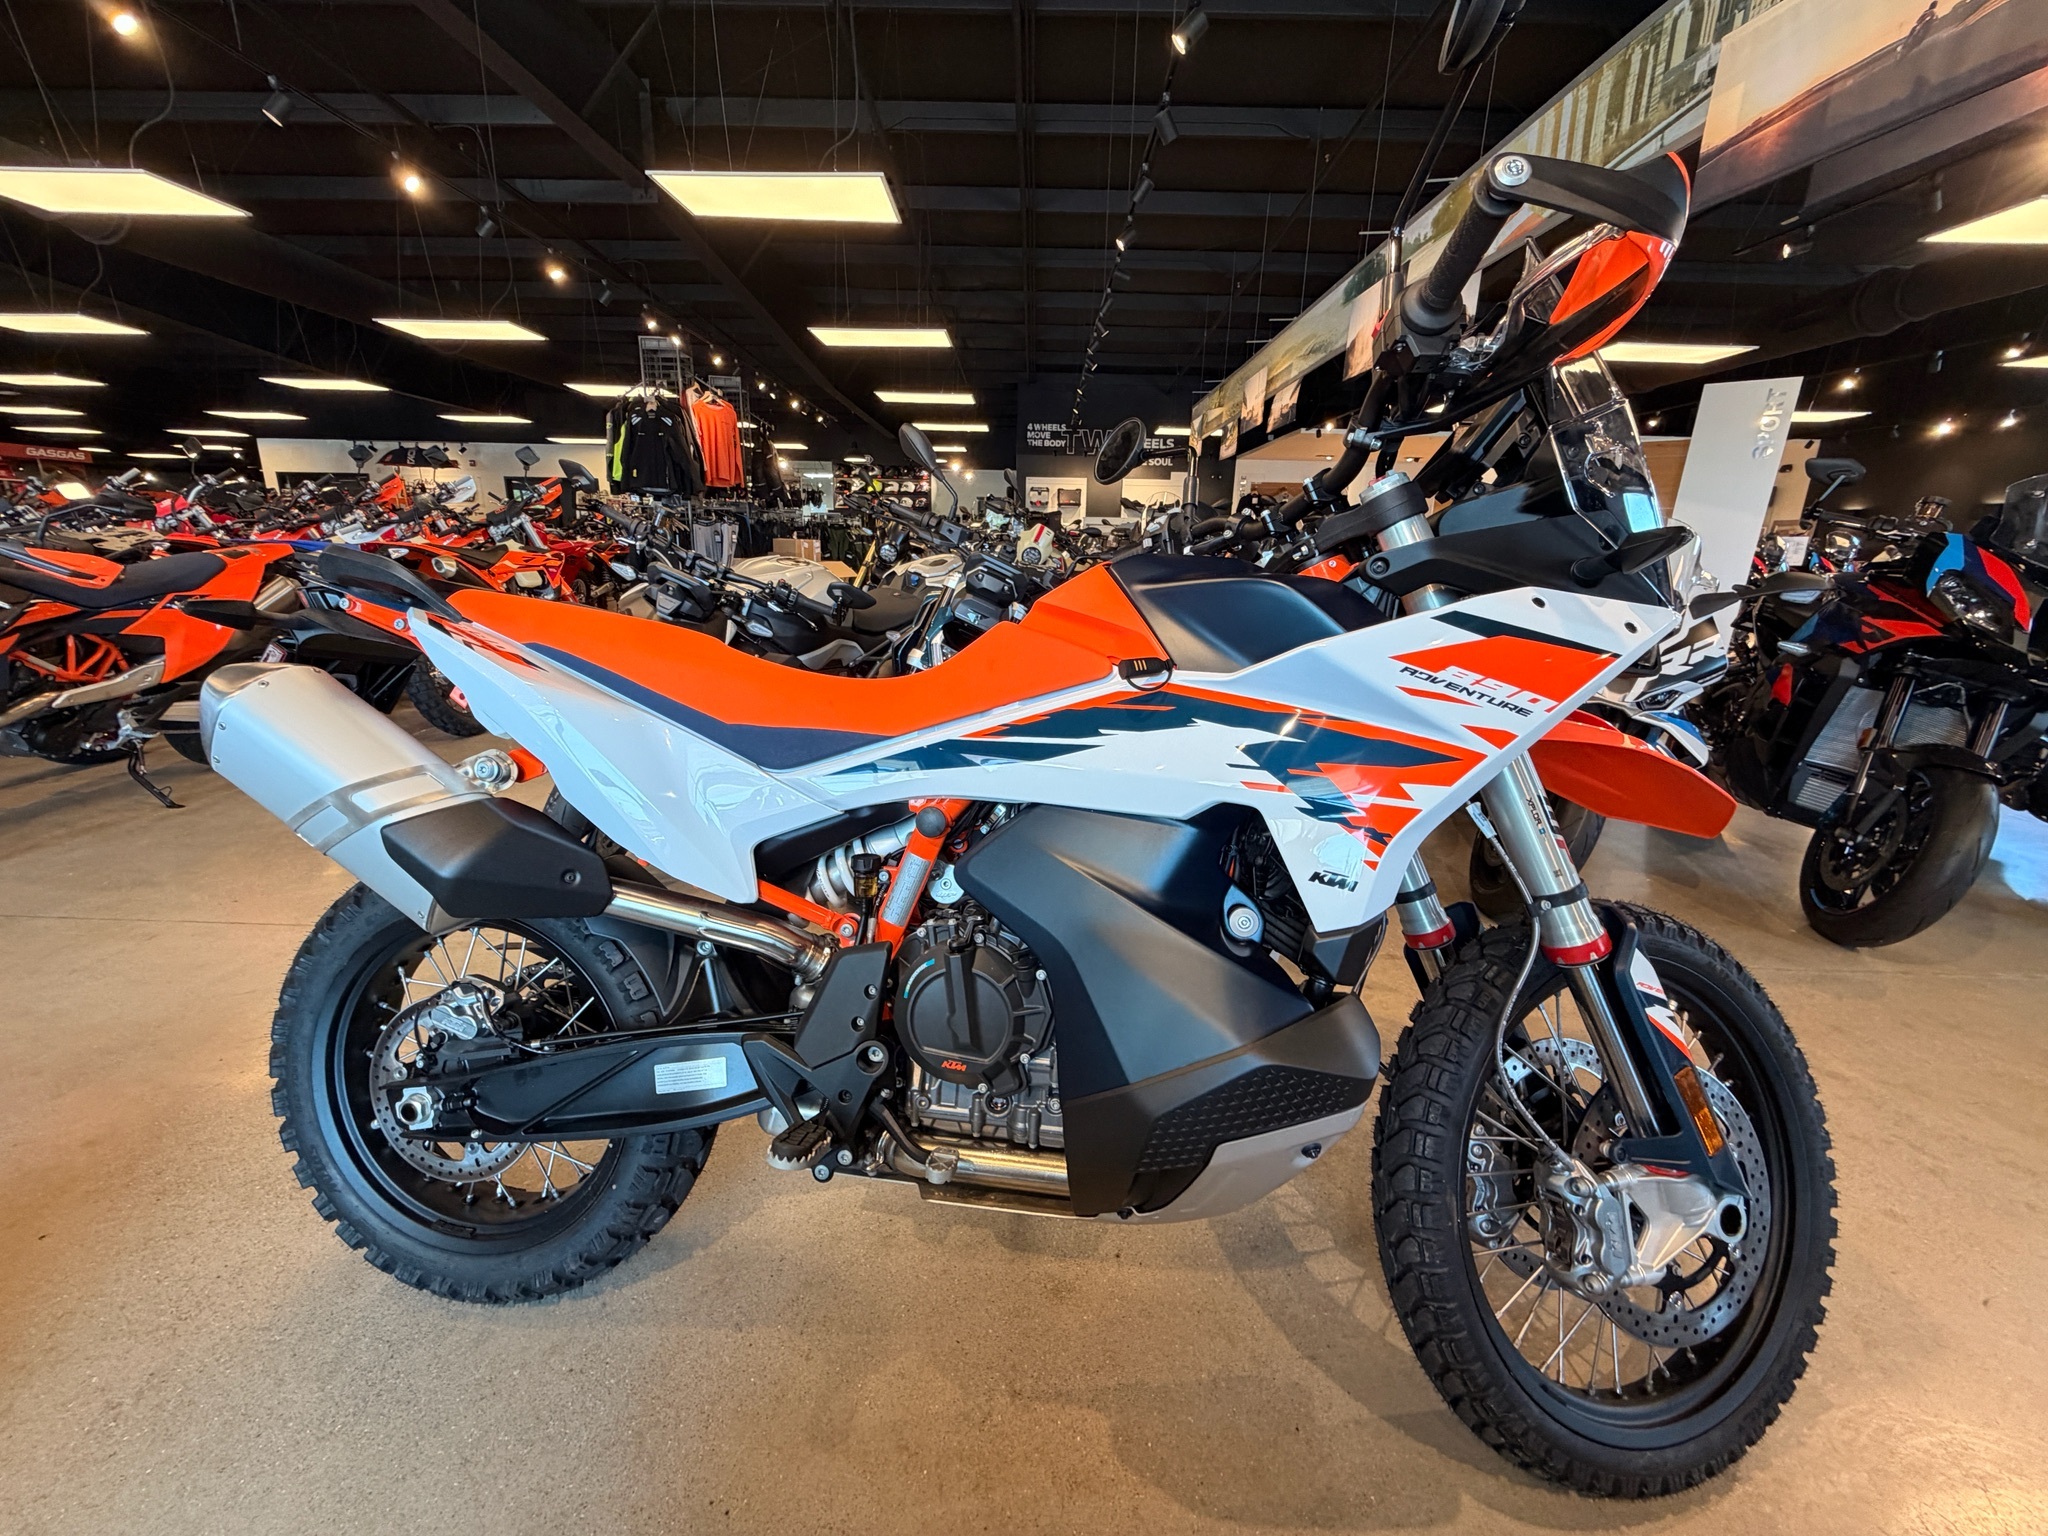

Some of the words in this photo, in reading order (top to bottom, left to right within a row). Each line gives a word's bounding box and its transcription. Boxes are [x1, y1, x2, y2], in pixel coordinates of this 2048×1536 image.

[1027, 423, 1033, 431] 4
[1034, 423, 1067, 431] WHEELS
[1027, 431, 1051, 439] MOVE
[1027, 439, 1043, 447] THE
[1044, 439, 1067, 447] BODY
[1061, 429, 1114, 455] TW
[1143, 438, 1175, 449] EELS
[25, 447, 86, 460] GASGAS
[1148, 458, 1173, 466] SOUL
[1399, 666, 1534, 718] ADVENTURE
[1525, 797, 1543, 826] XPLOR
[1308, 869, 1359, 893] KTM
[941, 1059, 967, 1072] KTM
